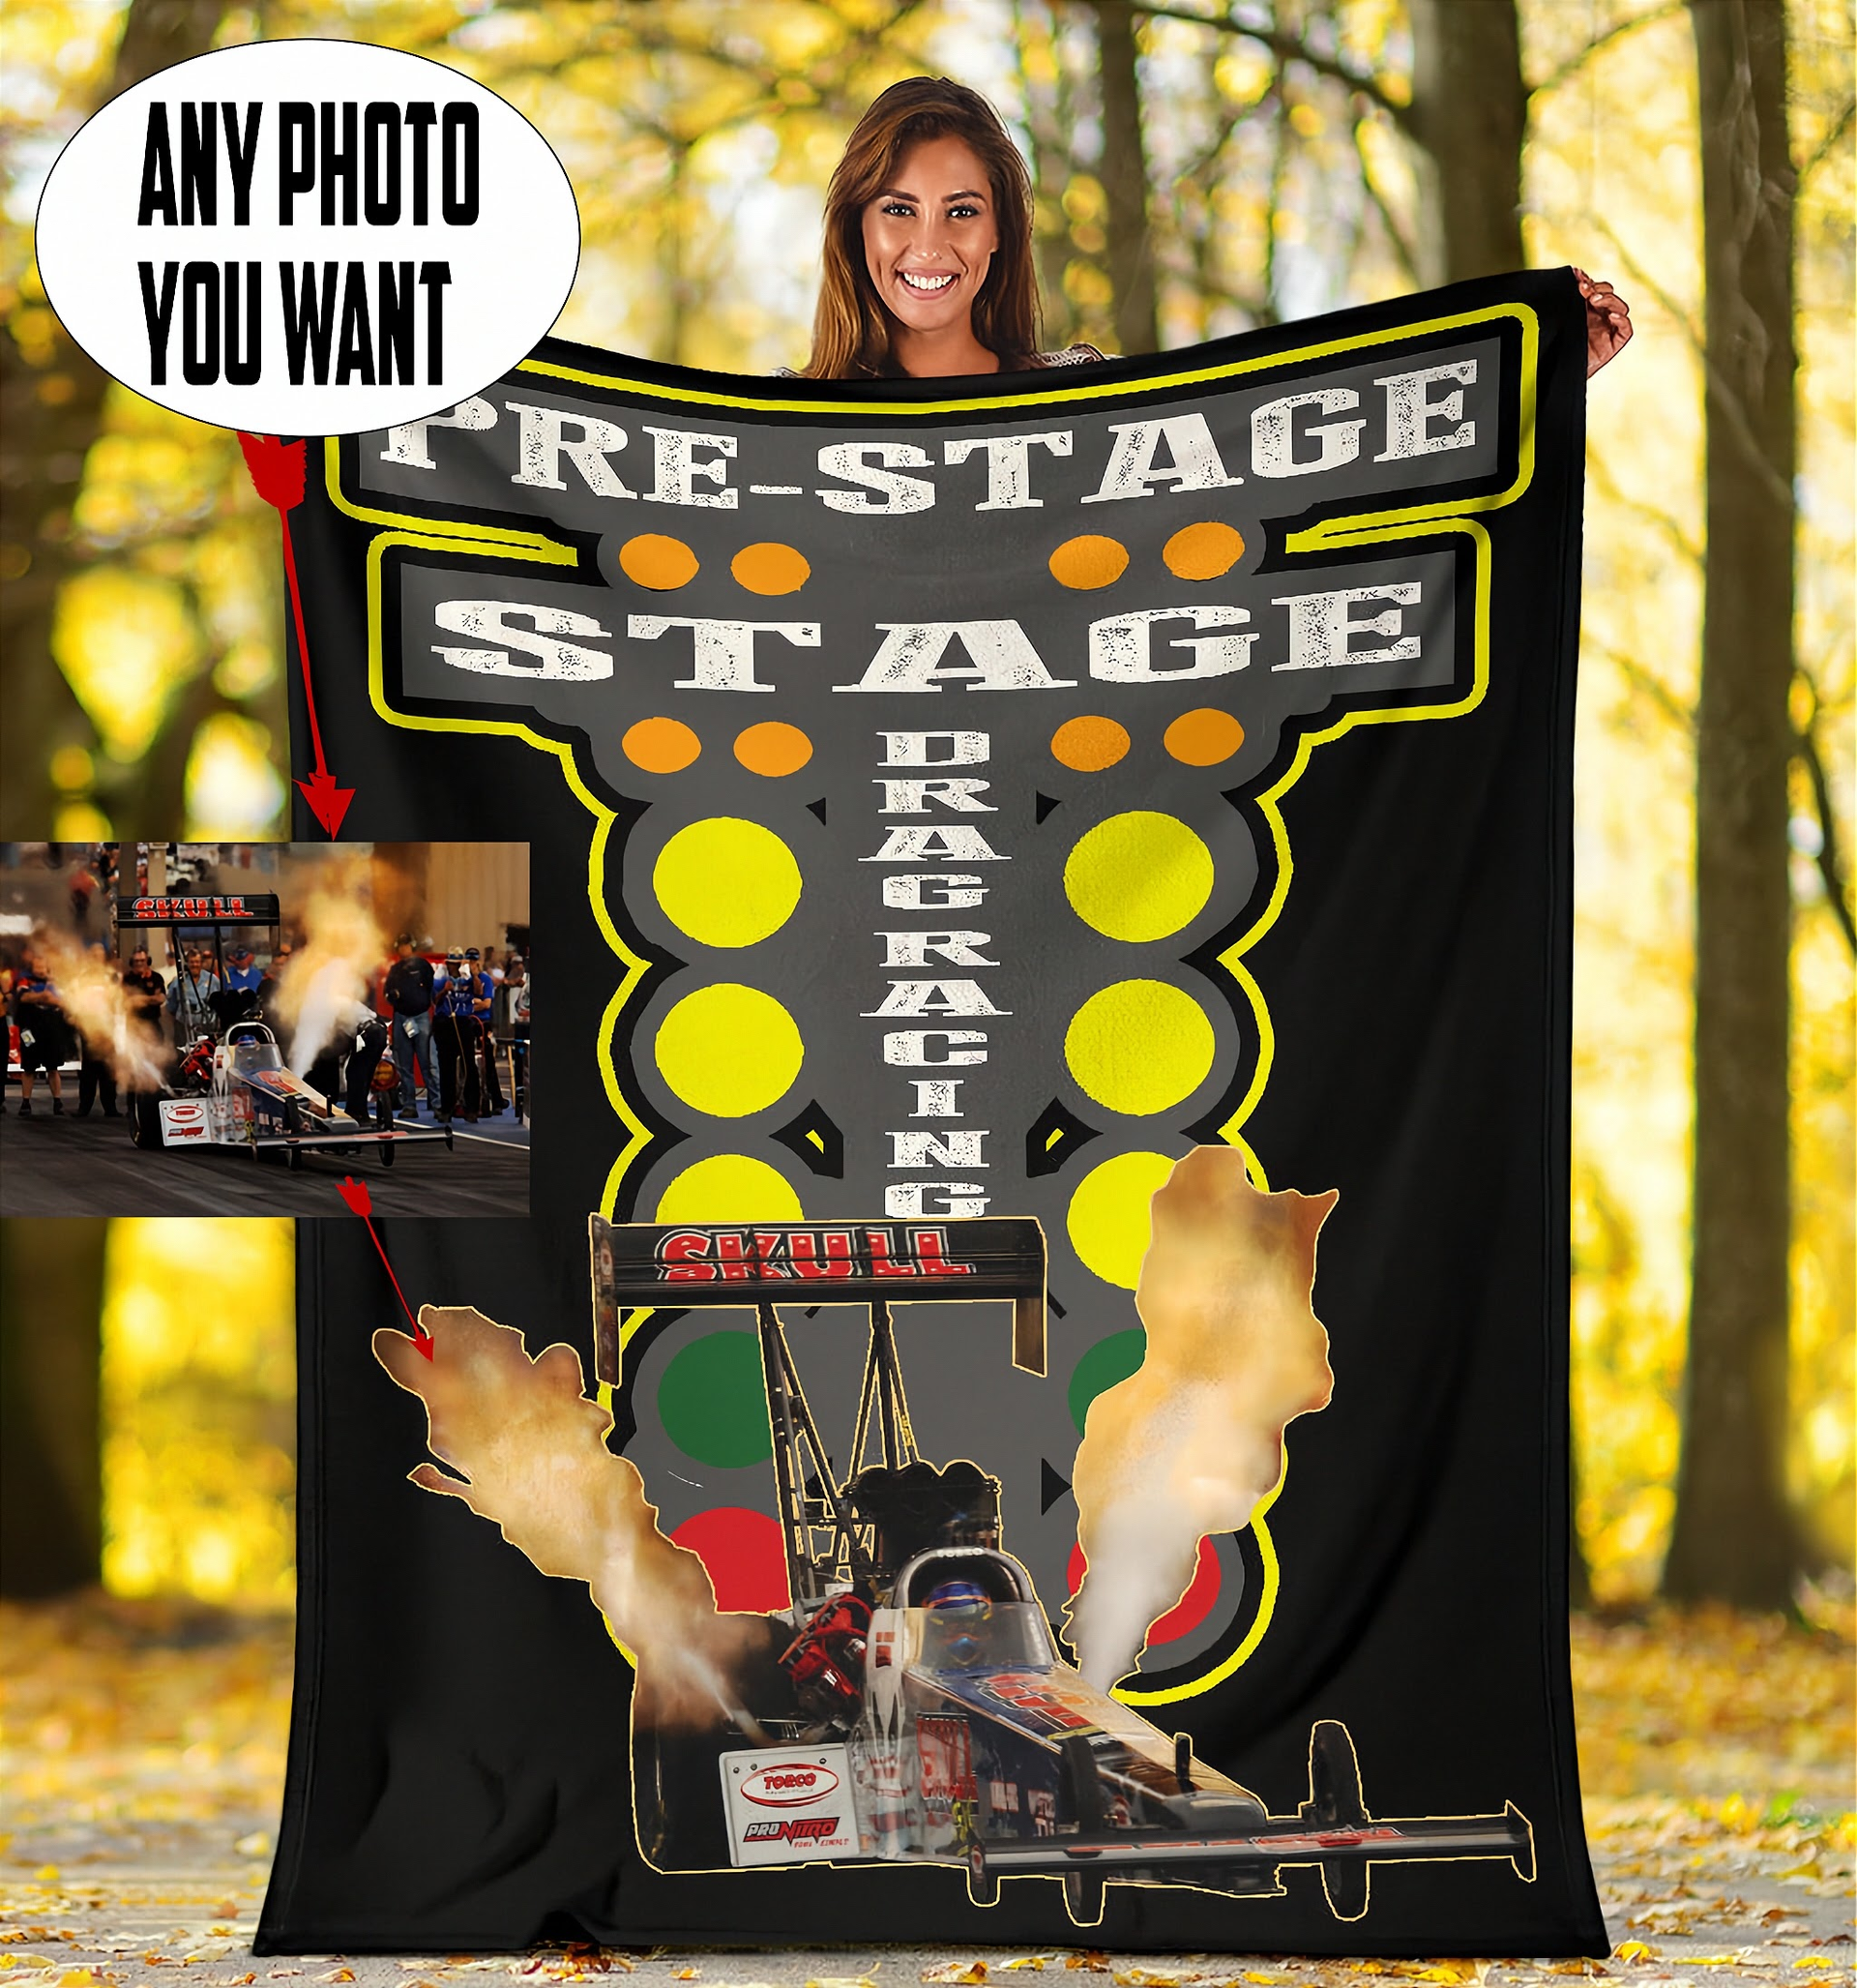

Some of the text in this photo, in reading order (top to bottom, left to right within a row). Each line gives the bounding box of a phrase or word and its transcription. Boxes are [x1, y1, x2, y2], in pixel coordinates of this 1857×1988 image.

[380, 359, 1479, 515] PRE-STAGE
[430, 581, 1423, 694] STAGE
[132, 896, 254, 918] SKULL
[656, 1227, 977, 1282] SKULL
